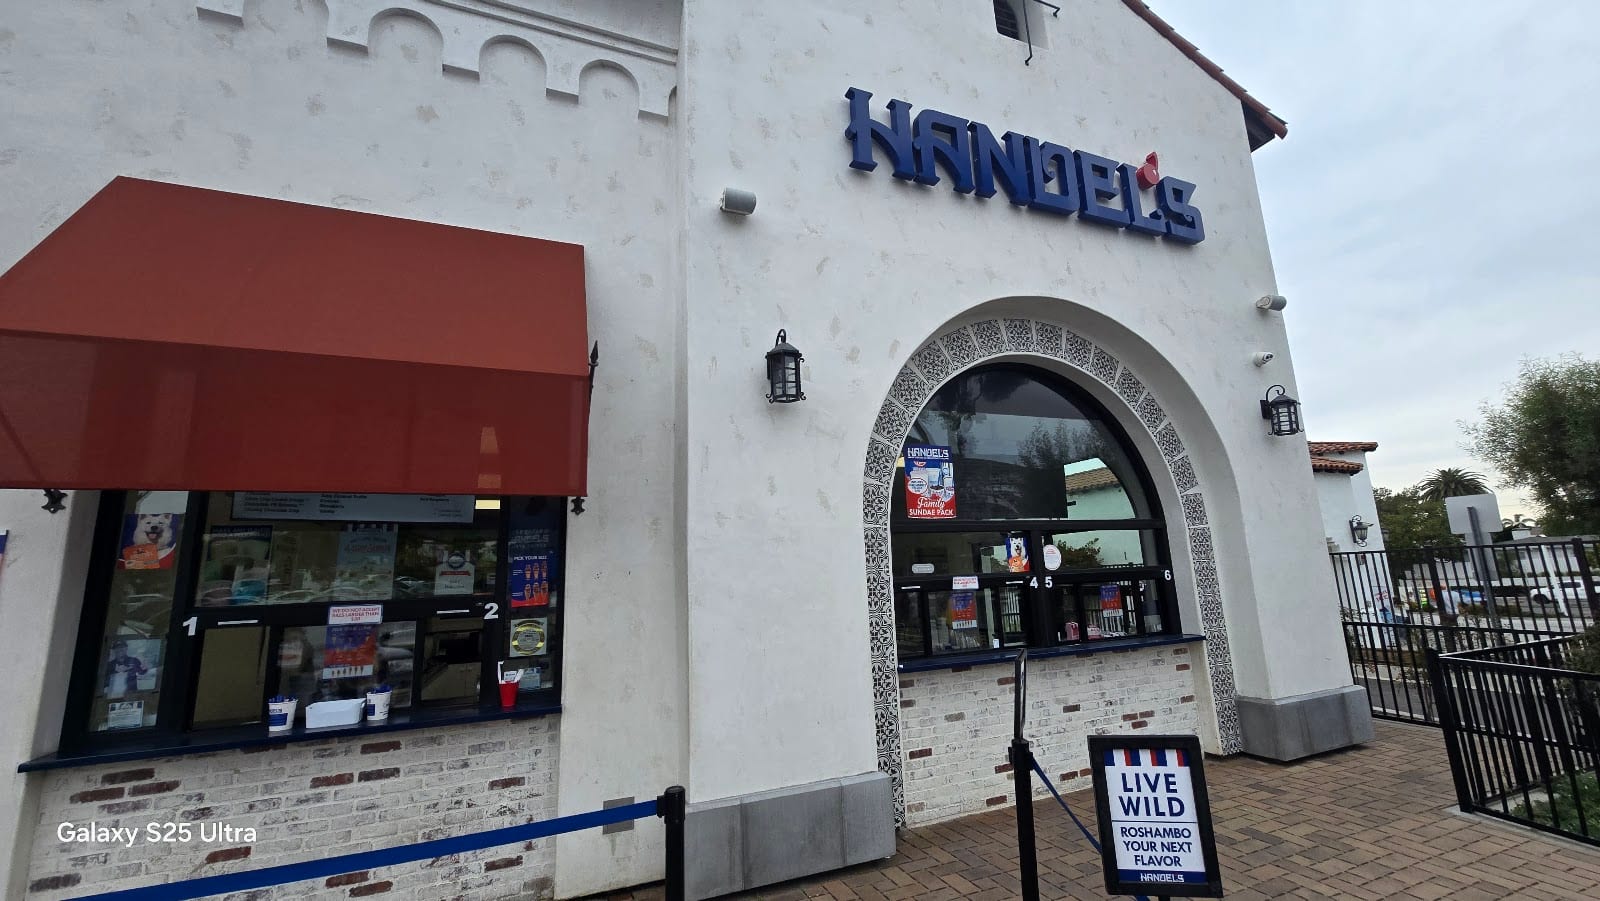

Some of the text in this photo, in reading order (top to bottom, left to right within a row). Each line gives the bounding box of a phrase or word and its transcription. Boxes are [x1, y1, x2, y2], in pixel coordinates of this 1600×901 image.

[917, 497, 945, 510] Family
[909, 508, 935, 516] SUNDAE
[1044, 576, 1053, 588] 5
[1164, 570, 1172, 581] 6
[1029, 576, 1038, 589] 4
[483, 602, 499, 620] 2
[182, 616, 198, 636] 1
[1121, 772, 1178, 794] LIVE
[1118, 795, 1185, 817] WILD
[1120, 826, 1192, 839] ROSHAMBO
[1123, 840, 1193, 854] YOUR NEXT
[1134, 855, 1183, 868] FLAVOR
